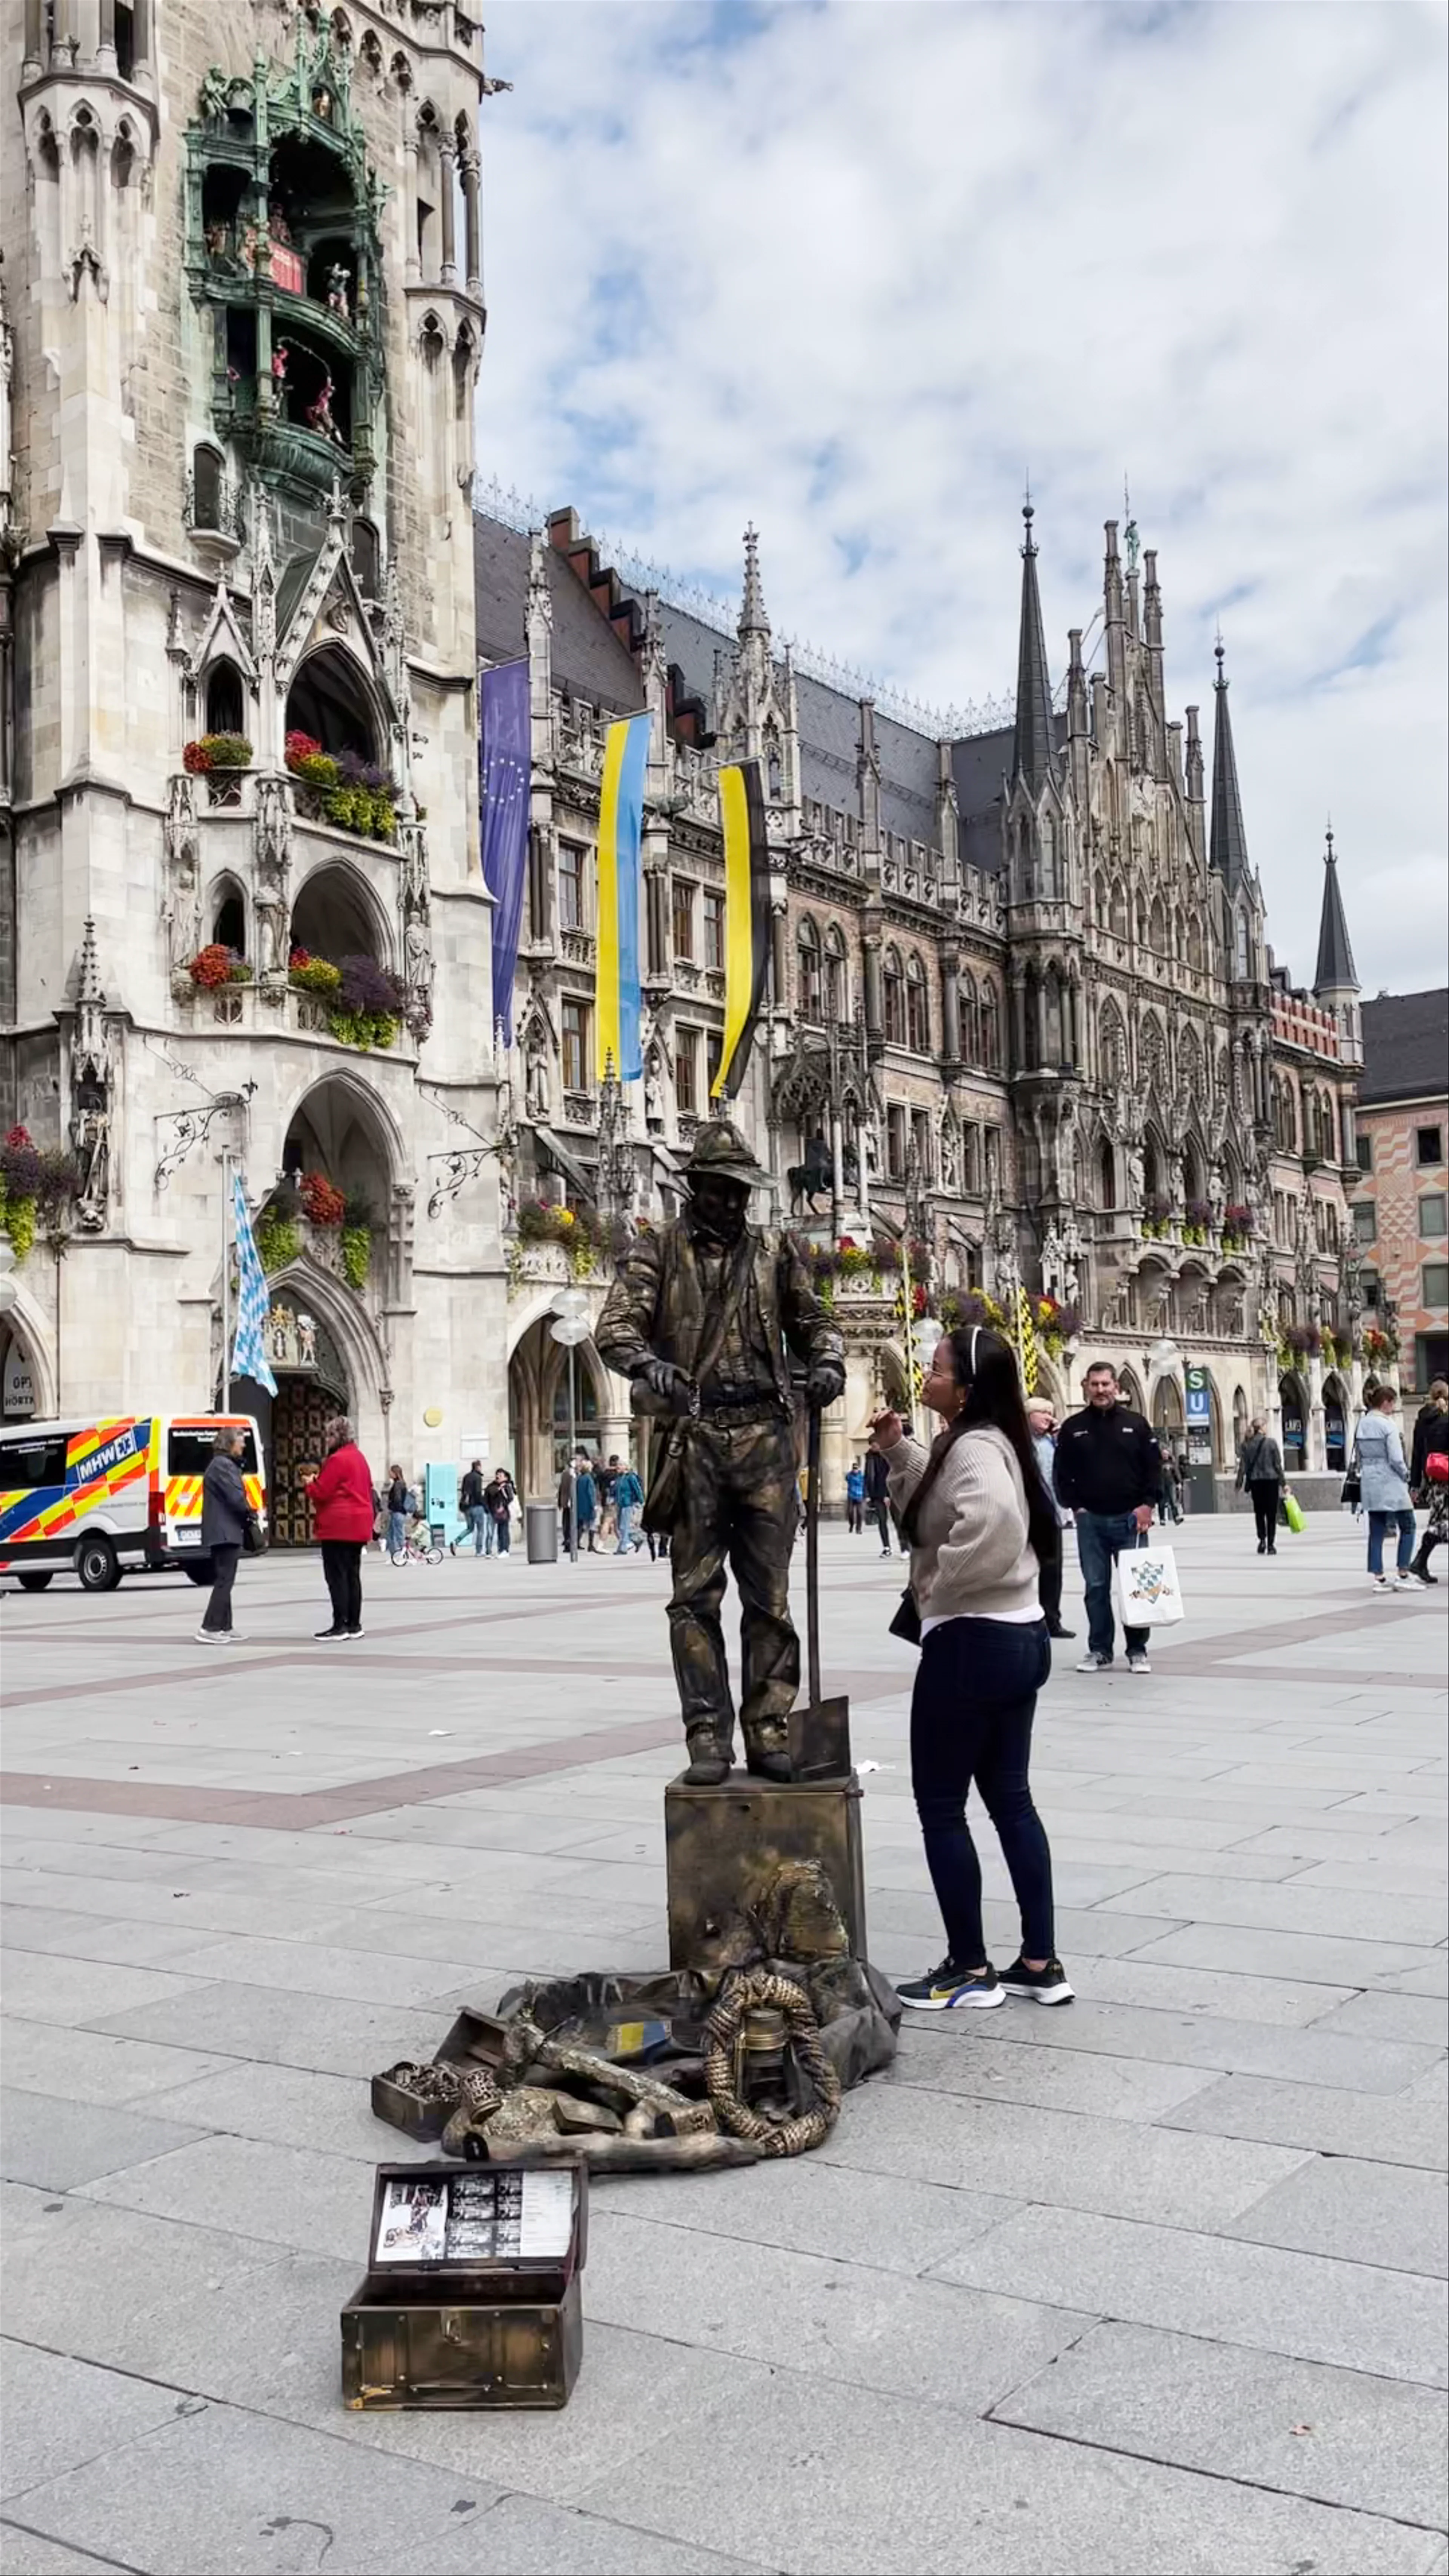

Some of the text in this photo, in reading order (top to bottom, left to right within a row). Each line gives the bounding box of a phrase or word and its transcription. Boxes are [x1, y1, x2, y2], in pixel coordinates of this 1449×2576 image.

[1189, 1370, 1203, 1389] S
[1191, 1393, 1203, 1411] U
[80, 1444, 115, 1480] MHW
